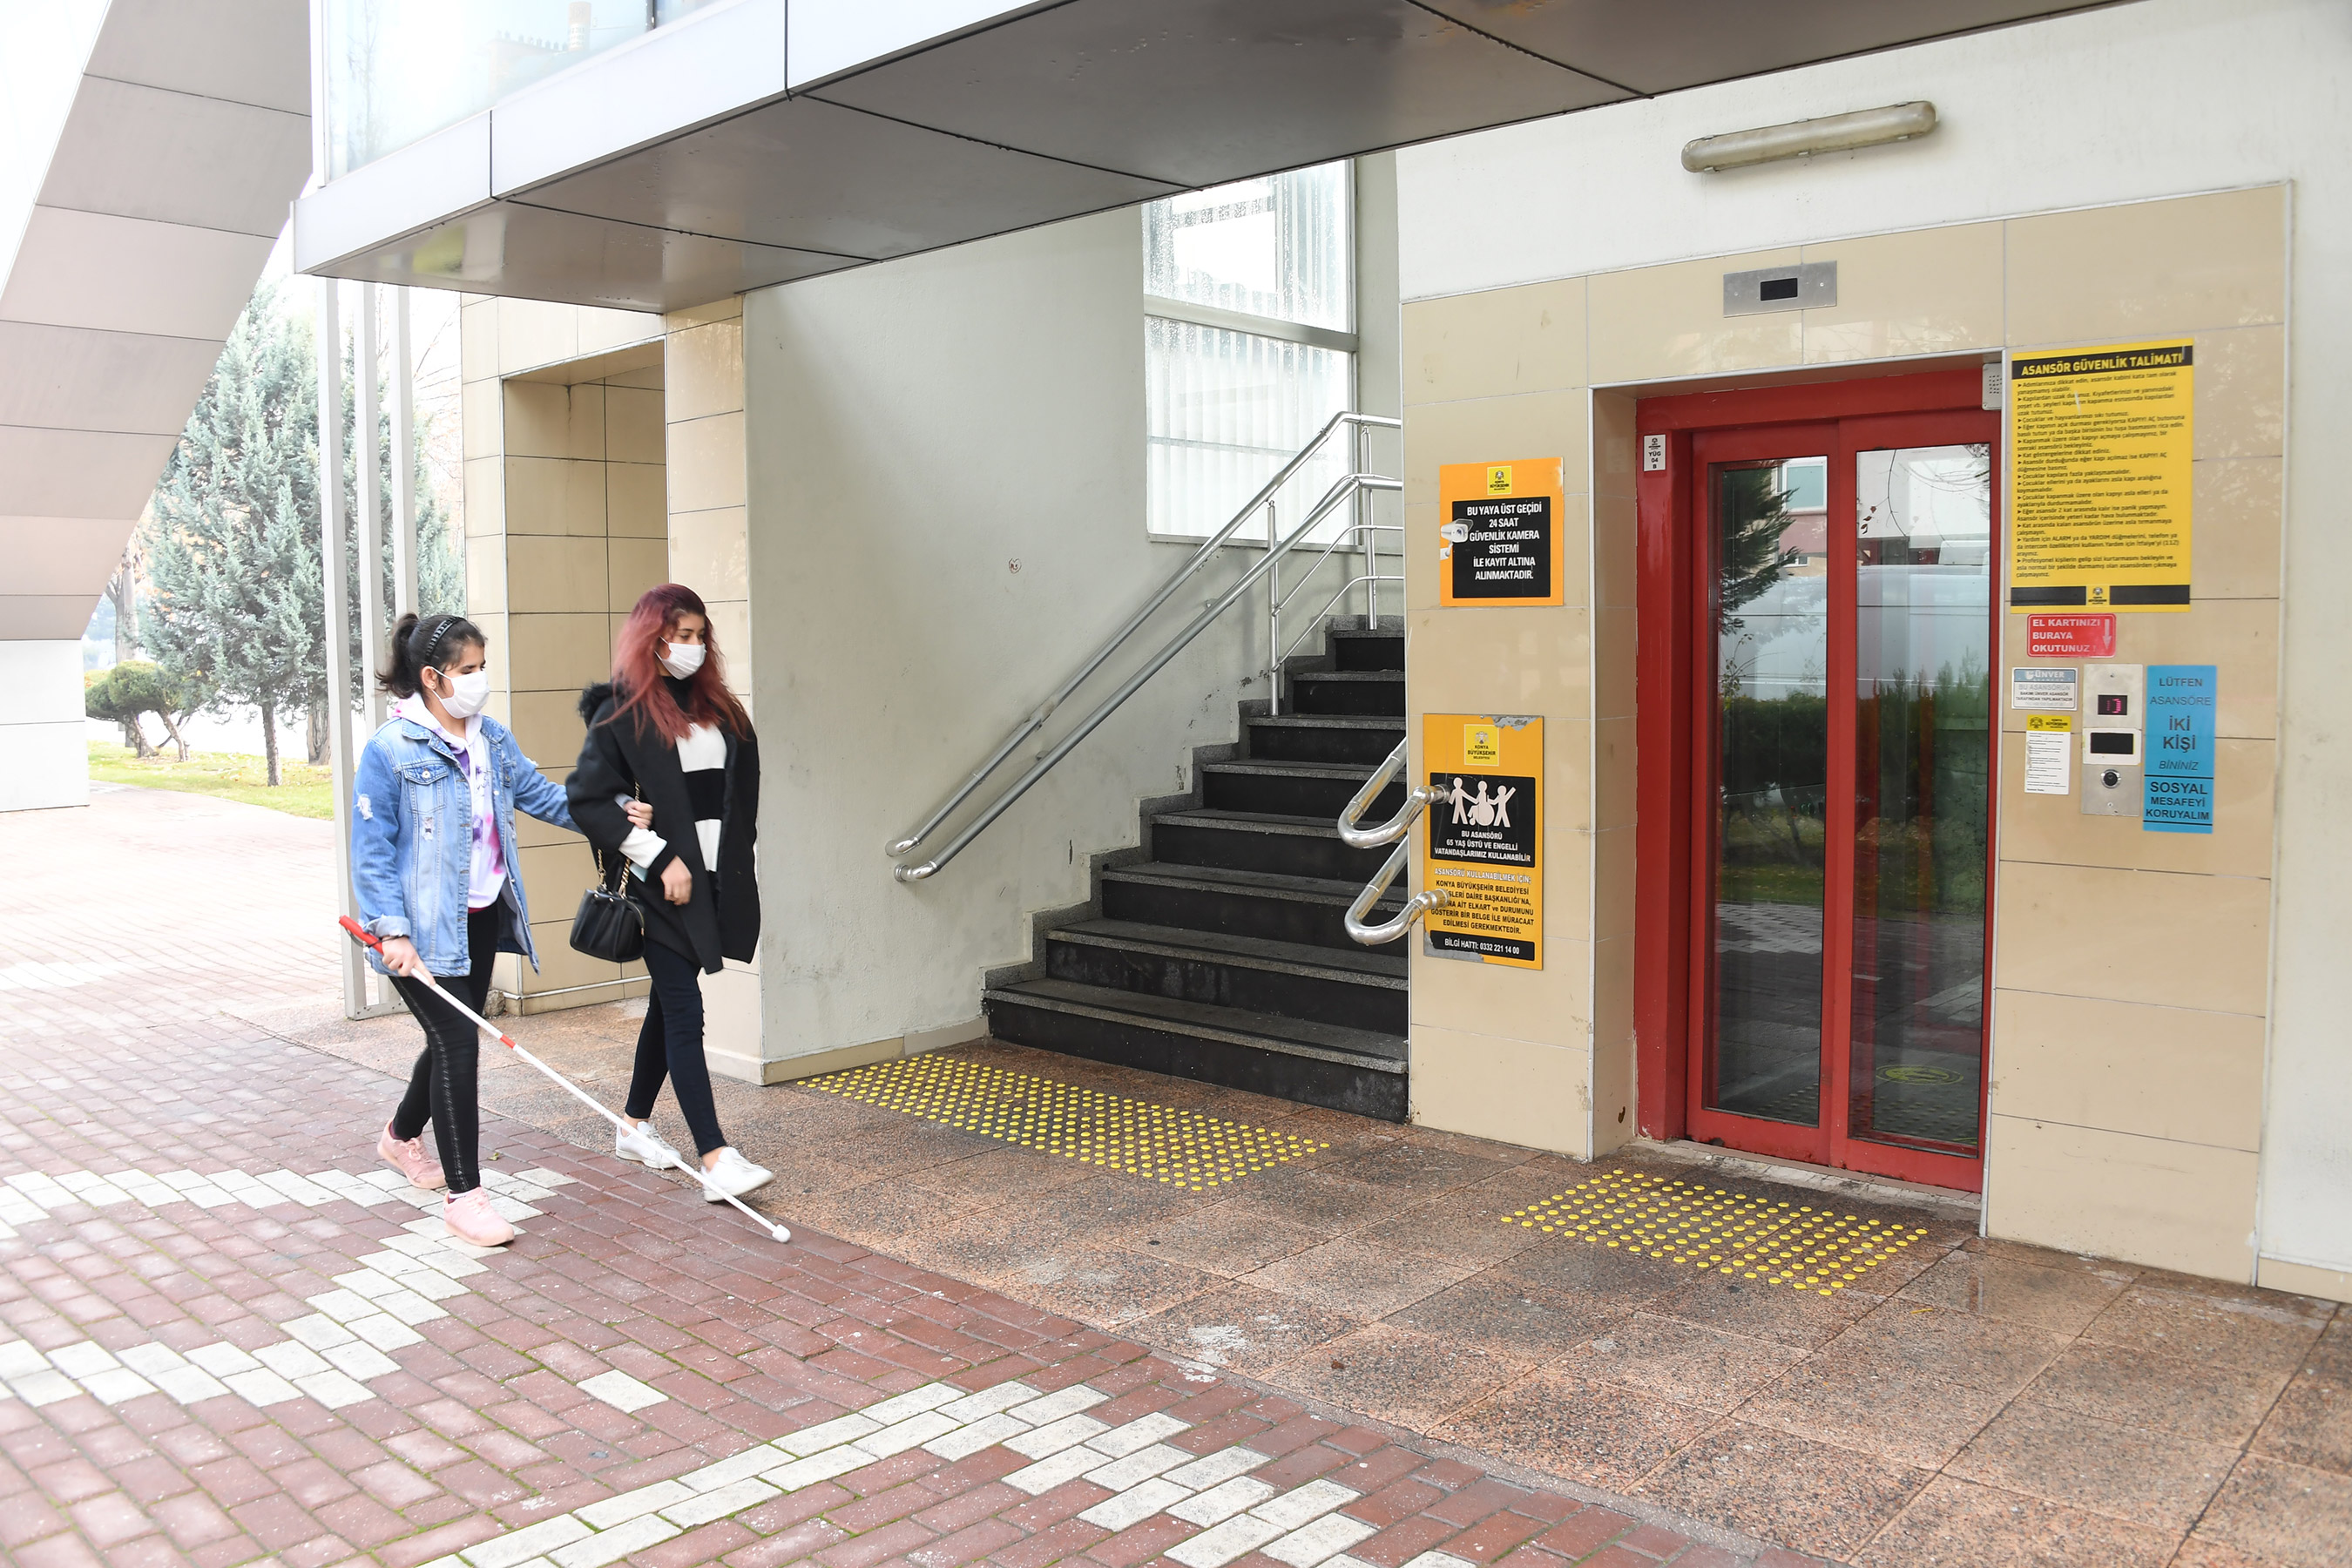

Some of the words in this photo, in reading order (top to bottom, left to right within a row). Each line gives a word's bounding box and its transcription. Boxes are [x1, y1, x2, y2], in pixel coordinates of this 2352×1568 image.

[2021, 361, 2071, 375] ASANSÖR
[2073, 356, 2127, 371] GÜVENLİK
[2129, 353, 2183, 367] TALİMATI
[1467, 506, 1478, 516] BU
[1479, 505, 1500, 515] YAYA
[1501, 503, 1516, 514] ÜST
[1517, 502, 1542, 515] GEÇİDİ
[1489, 519, 1498, 528] 24
[1498, 518, 1519, 527] SAAT
[1470, 530, 1506, 541] GÜVENLİK
[1507, 530, 1540, 540] KAMERA
[1489, 542, 1519, 554] SİSTEMİ
[1474, 556, 1484, 567] İLE
[1485, 557, 1507, 567] KAYIT
[1508, 557, 1536, 566] ALTINA
[1475, 570, 1533, 580] ALINMAKTADIR.
[2159, 677, 2202, 686] LÜTFEN
[2150, 695, 2211, 705] ASANSÖRE
[2169, 715, 2190, 731] İKİ
[2163, 734, 2195, 753] KİŞİ
[2159, 760, 2199, 770] BİNİNİZ
[2150, 782, 2208, 794] SOSYAL
[2151, 797, 2205, 807] MESAFEYİ
[2146, 809, 2209, 819] KORUYALIM
[1471, 831, 1502, 840] ASANSÖRÜ
[1455, 840, 1466, 848] YAŞ
[1467, 839, 1483, 848] ÜSTÜ
[1493, 842, 1518, 851] ENGELLİ
[1434, 848, 1487, 858] VATANDAŞLARIMIZ
[1488, 852, 1530, 862] KULLANABİLİR
[1434, 868, 1465, 877] ASANSÖRÜ
[1467, 870, 1515, 881] KULLANABİLMEK
[1517, 873, 1531, 883] İÇİN;
[1457, 881, 1494, 891] BÜYÜKŞEHİR
[1495, 885, 1529, 895] BELEDİYESİ
[1466, 892, 1483, 900] DAİRE
[1484, 894, 1531, 906] BAŞKANLIĞI'NA,
[1468, 902, 1491, 911] ELKART
[1500, 906, 1534, 916] DURUMUNU
[1431, 909, 1459, 918] GÖSTERİR
[1472, 912, 1490, 921] BELGE
[1492, 913, 1501, 922] İLE
[1502, 915, 1534, 925] MÜRACAAT
[1443, 919, 1469, 928] EDİLMESİ
[1471, 922, 1521, 934] GEREKMEKTEDİR.
[1445, 937, 1460, 947] BİLGİ
[1461, 940, 1479, 949] HATTI:
[1480, 943, 1493, 951] 0332
[1494, 944, 1503, 952] 221
